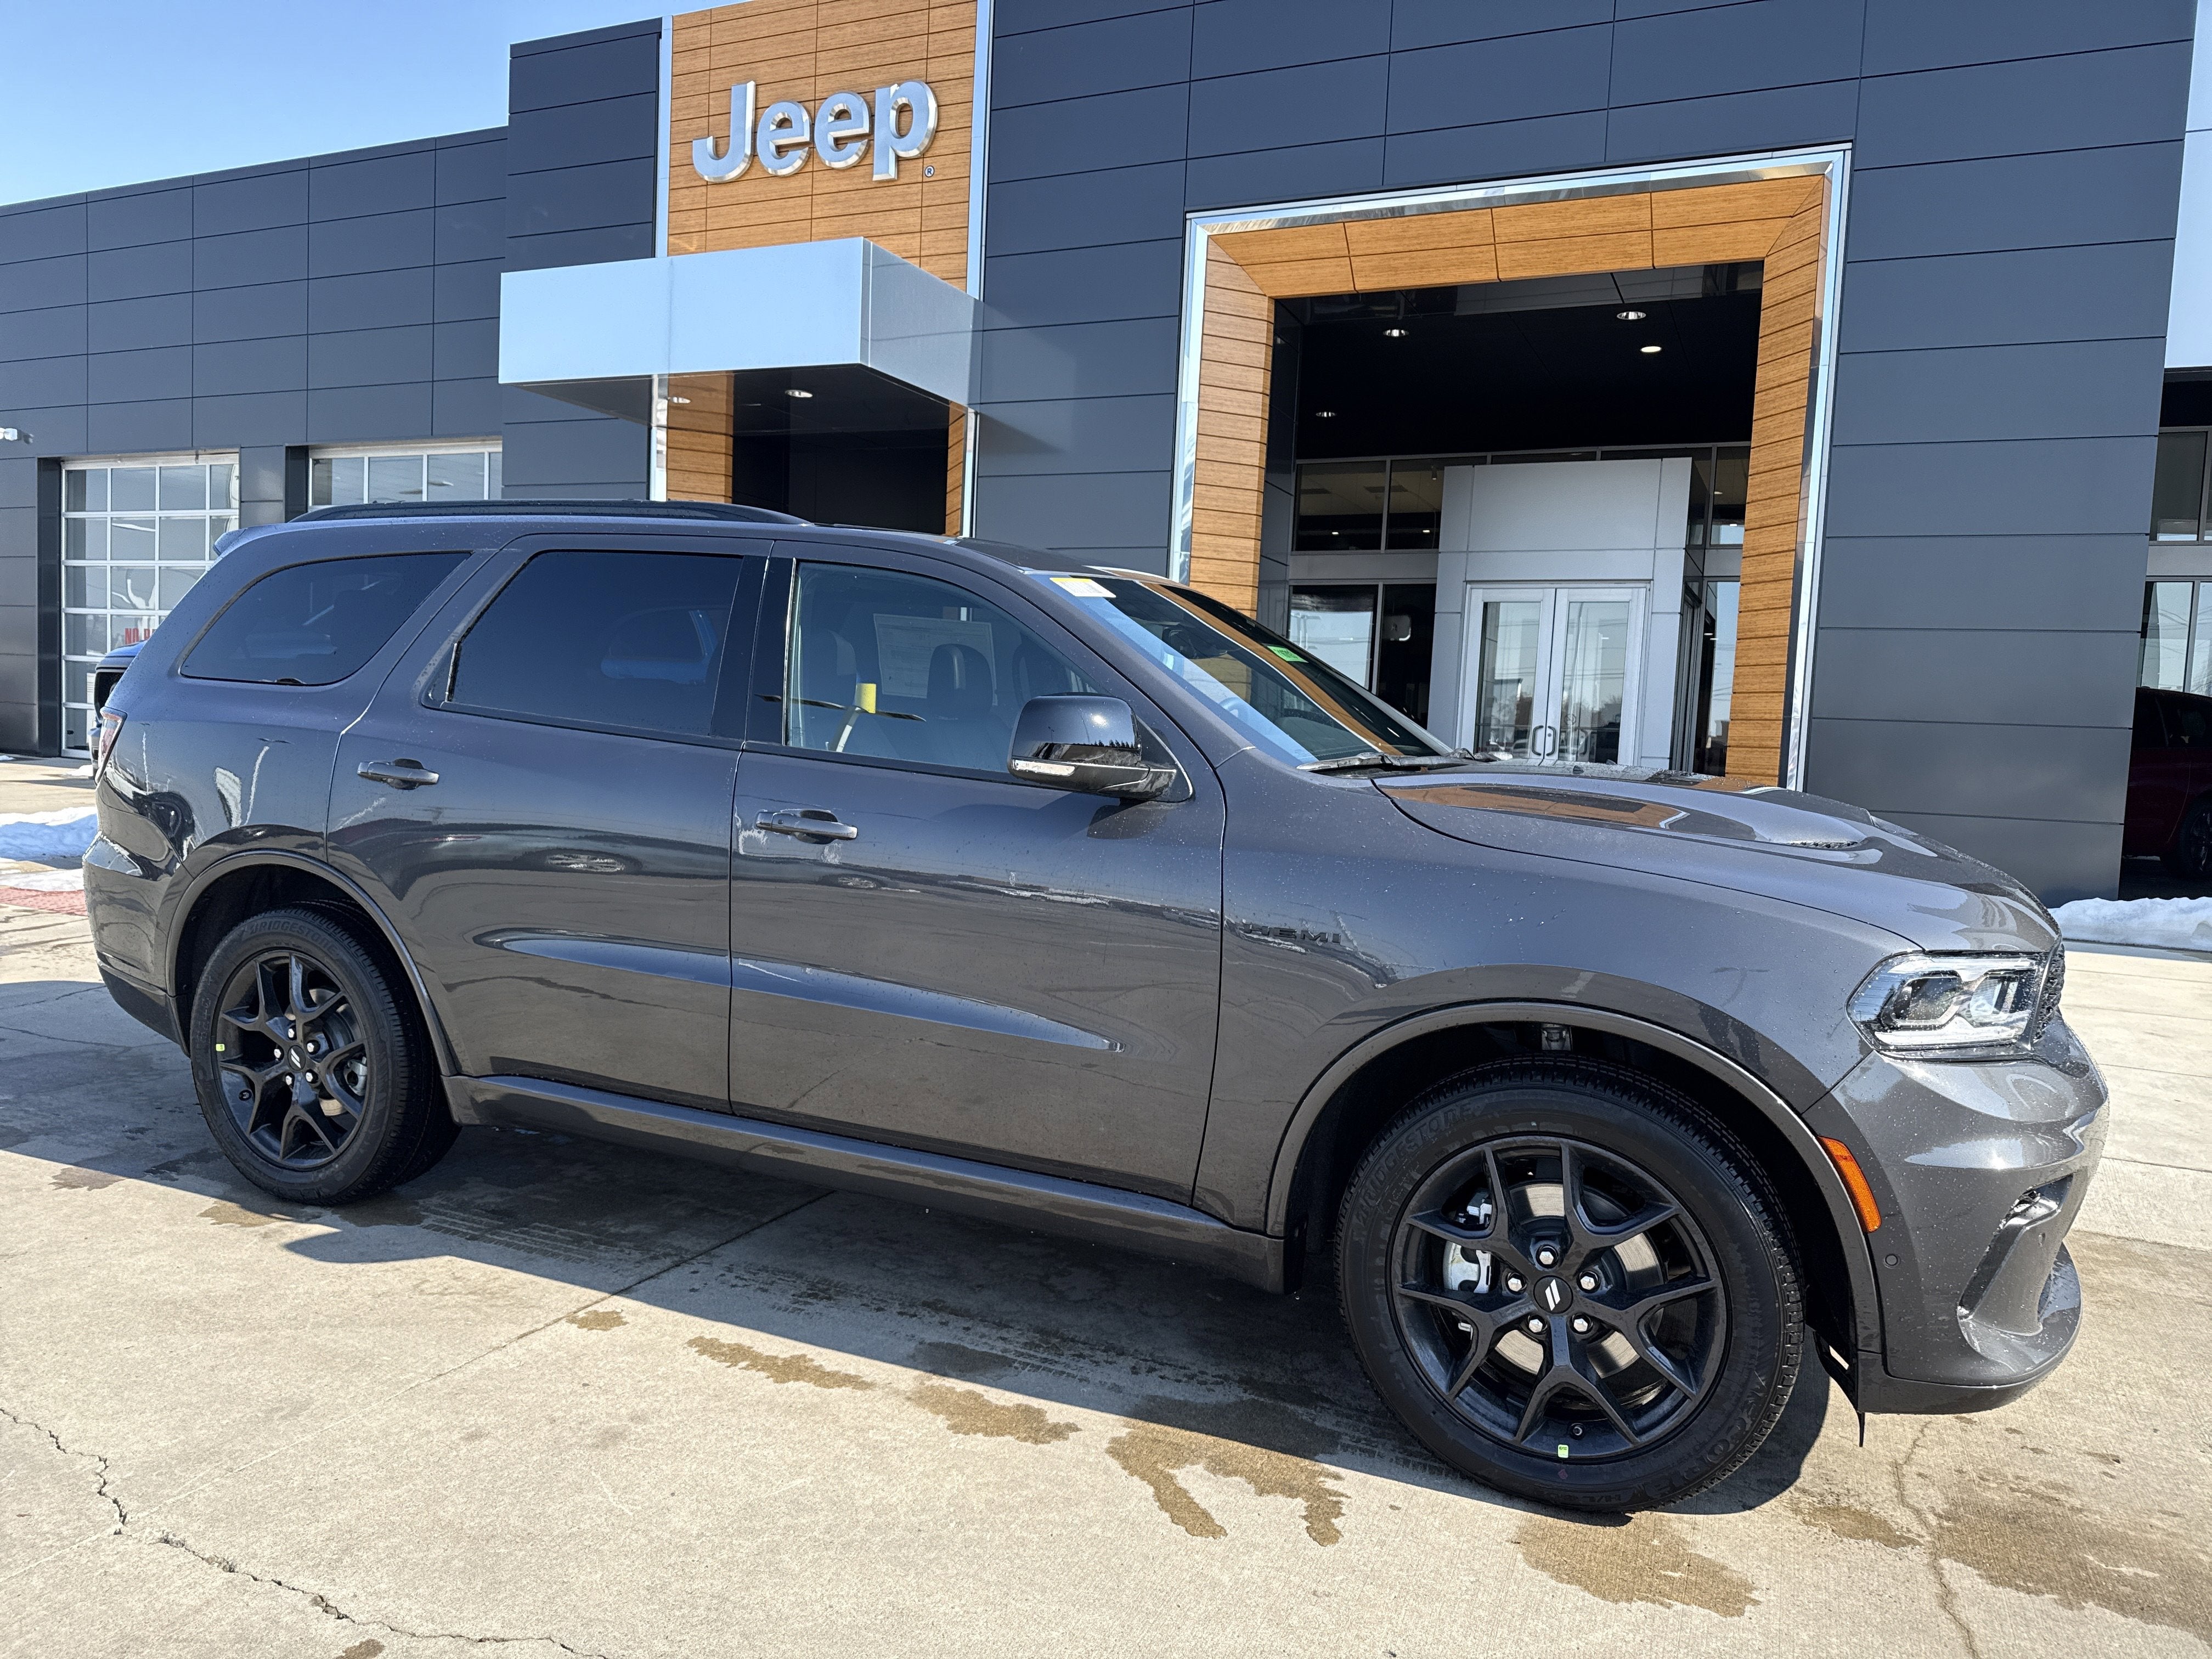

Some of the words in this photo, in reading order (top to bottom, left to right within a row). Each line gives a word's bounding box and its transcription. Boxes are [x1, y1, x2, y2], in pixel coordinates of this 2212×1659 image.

[692, 80, 938, 184] Jeep
[250, 920, 338, 954] BRIDGESTONE
[1243, 924, 1341, 945] HEMI
[1355, 1102, 1474, 1224] BRIDGESTONE
